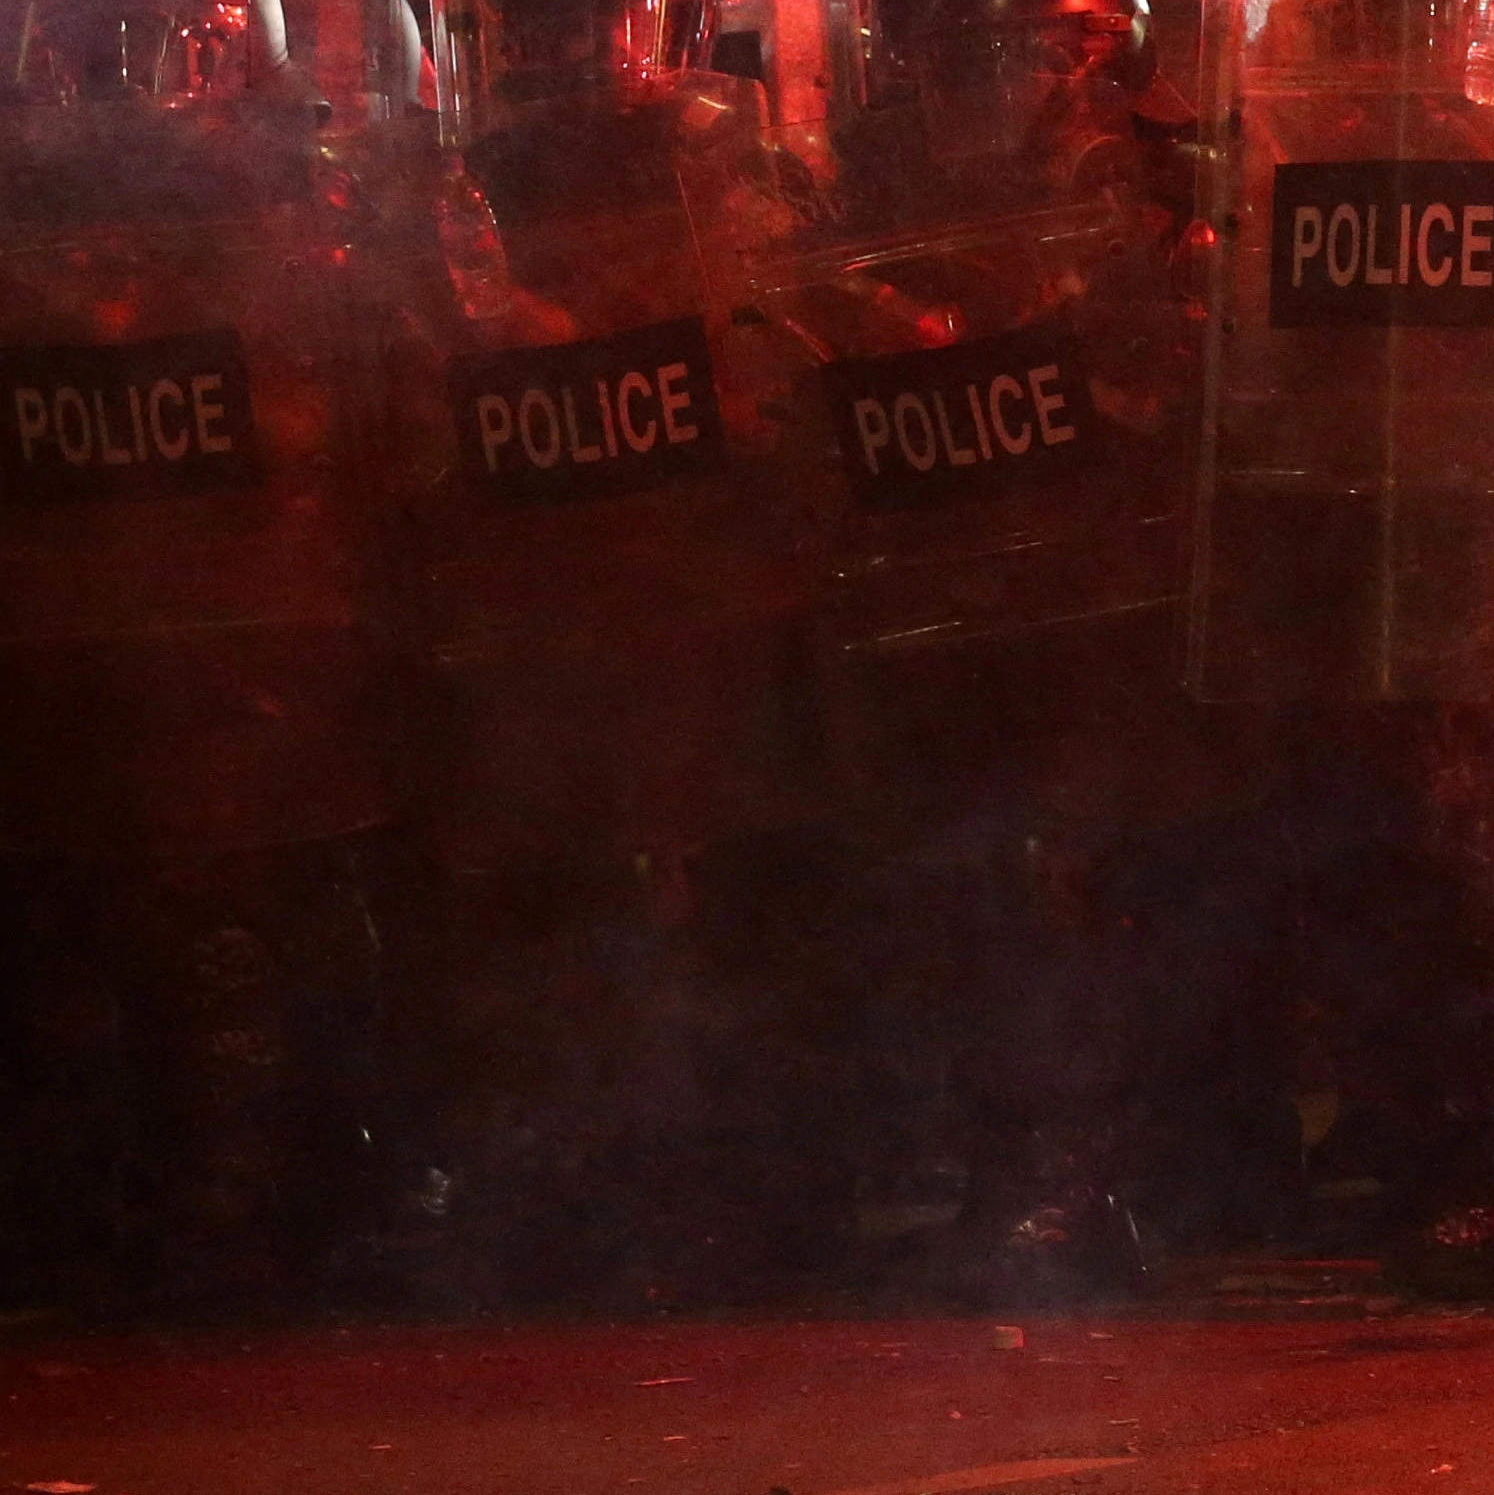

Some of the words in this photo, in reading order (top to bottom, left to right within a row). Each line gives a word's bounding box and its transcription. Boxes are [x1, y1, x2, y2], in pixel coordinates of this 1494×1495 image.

[1293, 202, 1494, 289] POLICE
[15, 373, 232, 467] POLICE
[478, 361, 700, 473] POLICE
[855, 364, 1078, 475] POLICE
